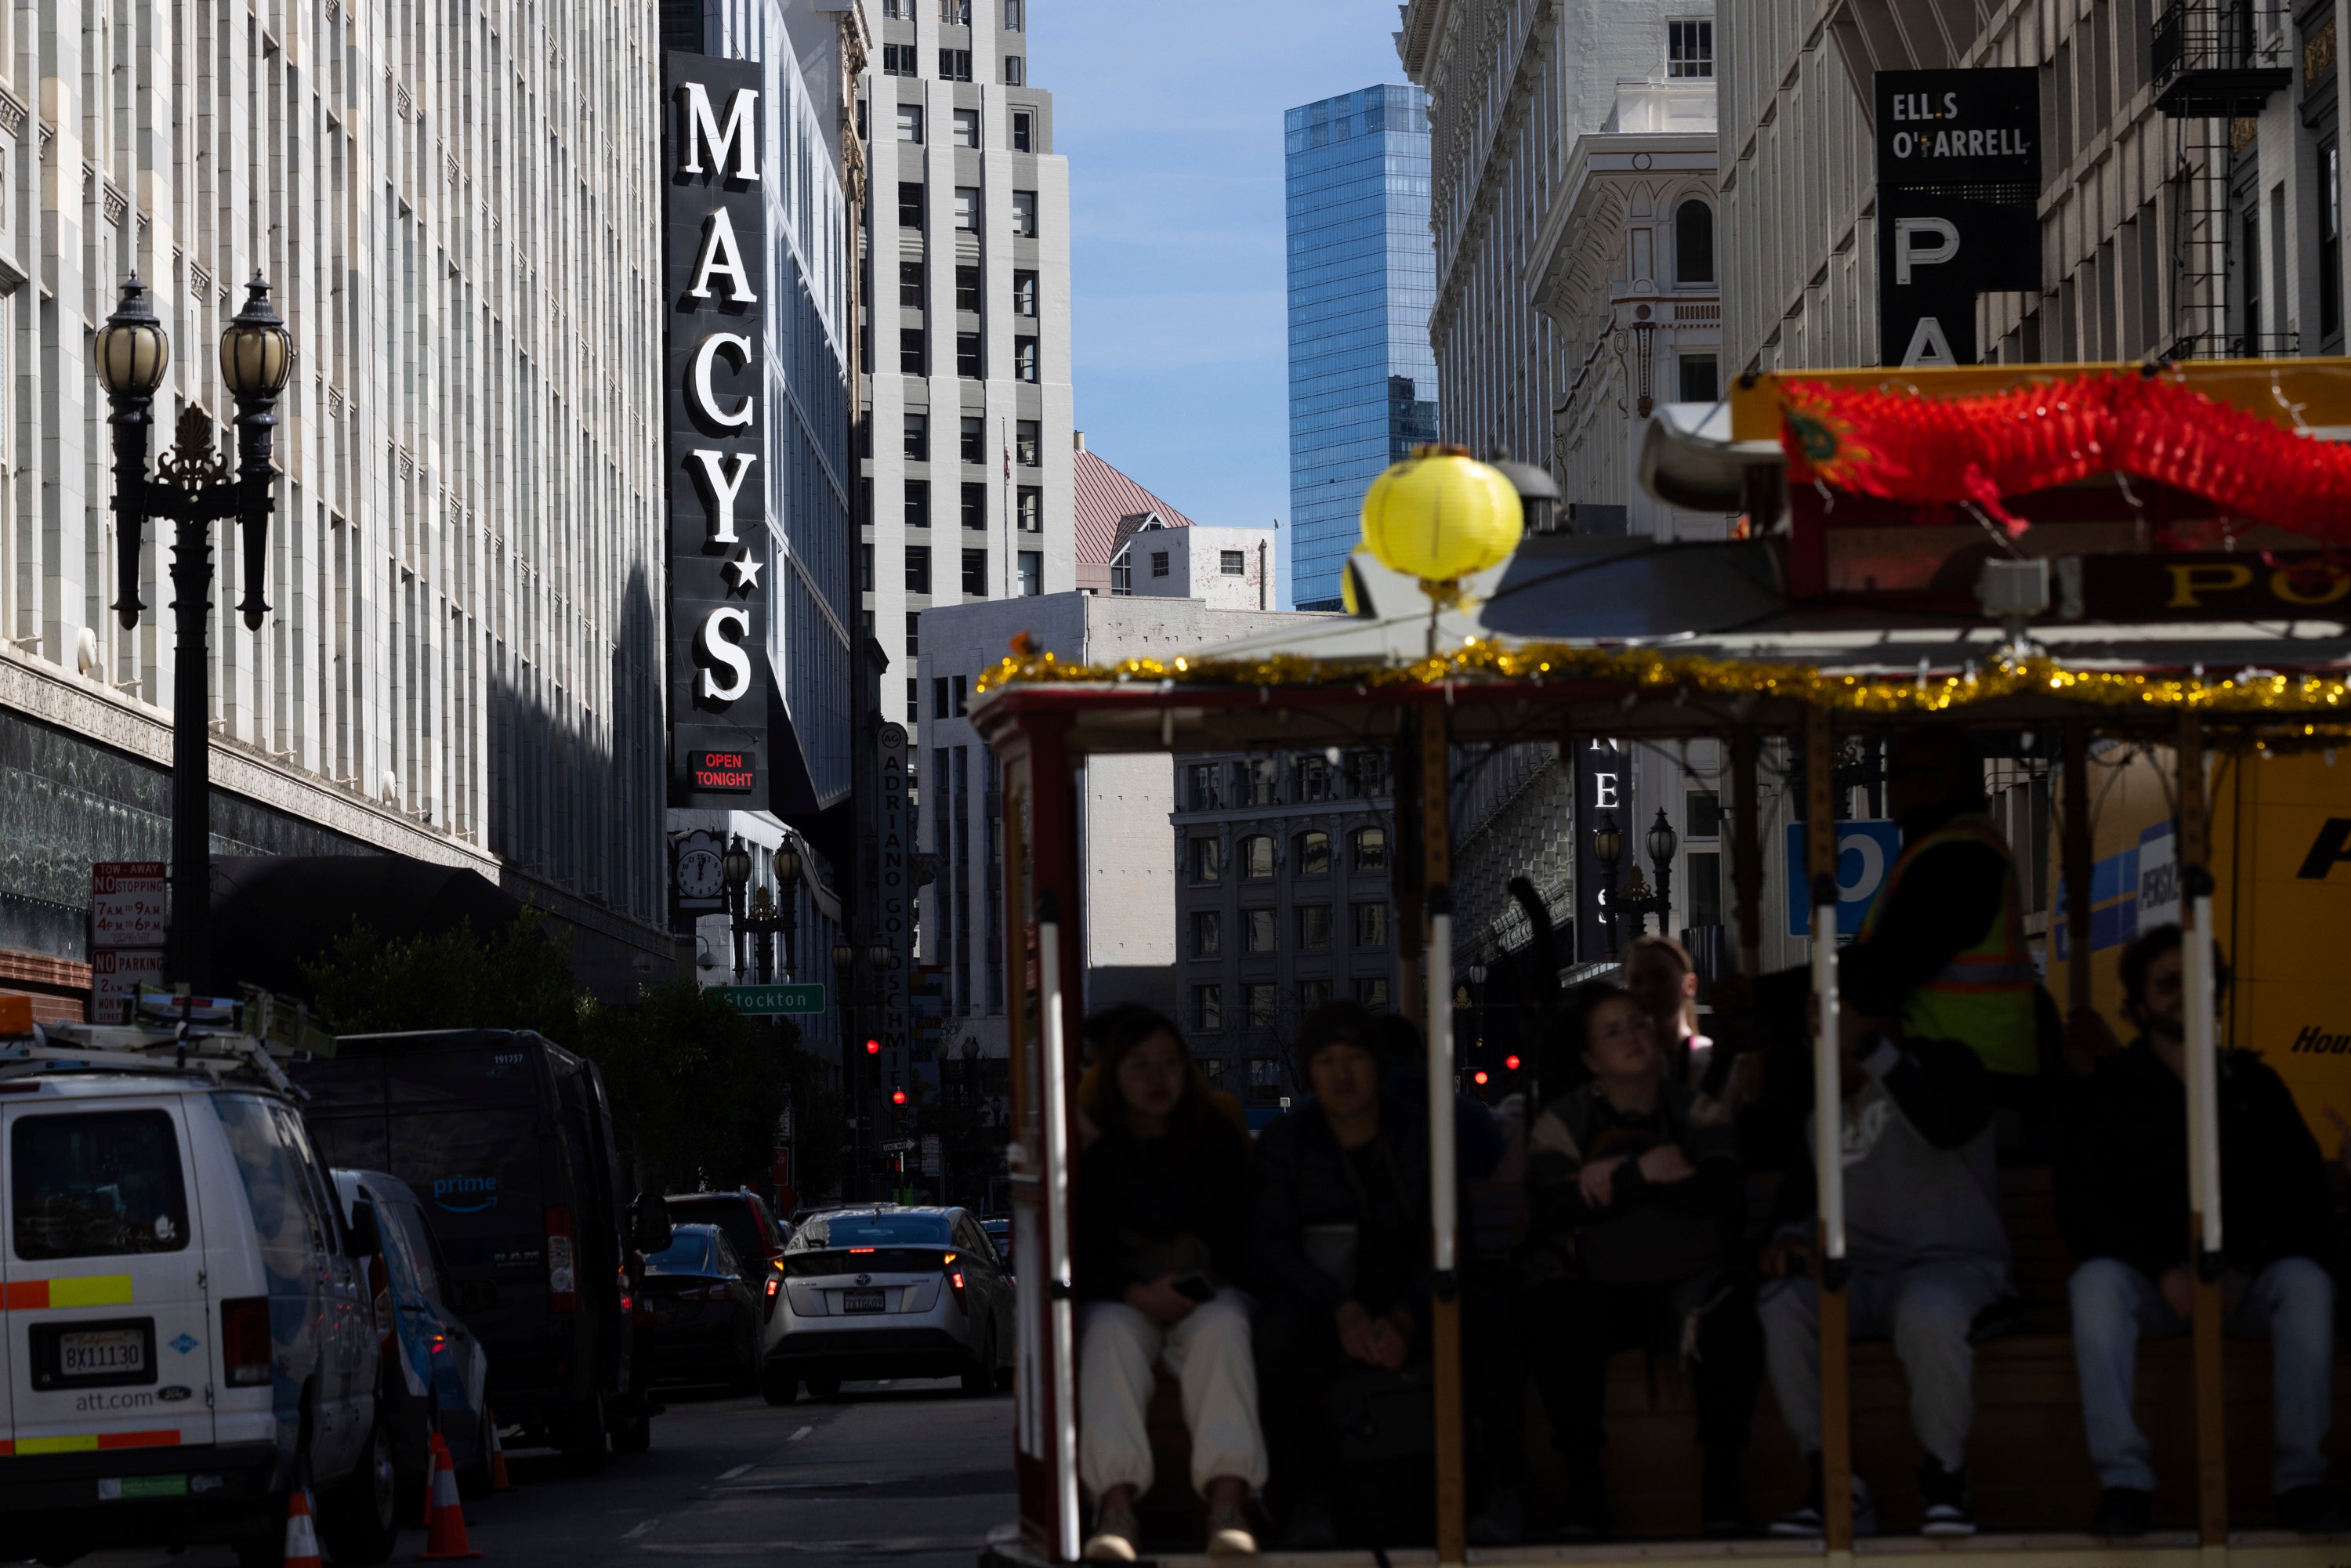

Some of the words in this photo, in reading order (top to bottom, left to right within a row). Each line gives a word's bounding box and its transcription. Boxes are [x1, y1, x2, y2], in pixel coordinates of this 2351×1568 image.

[705, 753, 742, 768] OPEN
[696, 771, 753, 787] TONIGHT
[885, 756, 901, 887] ADRIANO
[100, 864, 121, 875] TOW
[130, 864, 158, 875] AWAY
[95, 875, 115, 893] NO
[117, 881, 162, 893] STOPPING
[96, 954, 114, 972] NO
[119, 958, 163, 971] PARKING
[99, 998, 114, 1009] MON
[723, 992, 806, 1008] Stockton
[885, 898, 906, 1099] GOLDSCHMIE
[2291, 1026, 2351, 1055] Hou
[433, 1172, 498, 1198] prime
[67, 1345, 139, 1368] 8X11130
[76, 1392, 153, 1411] att.com
